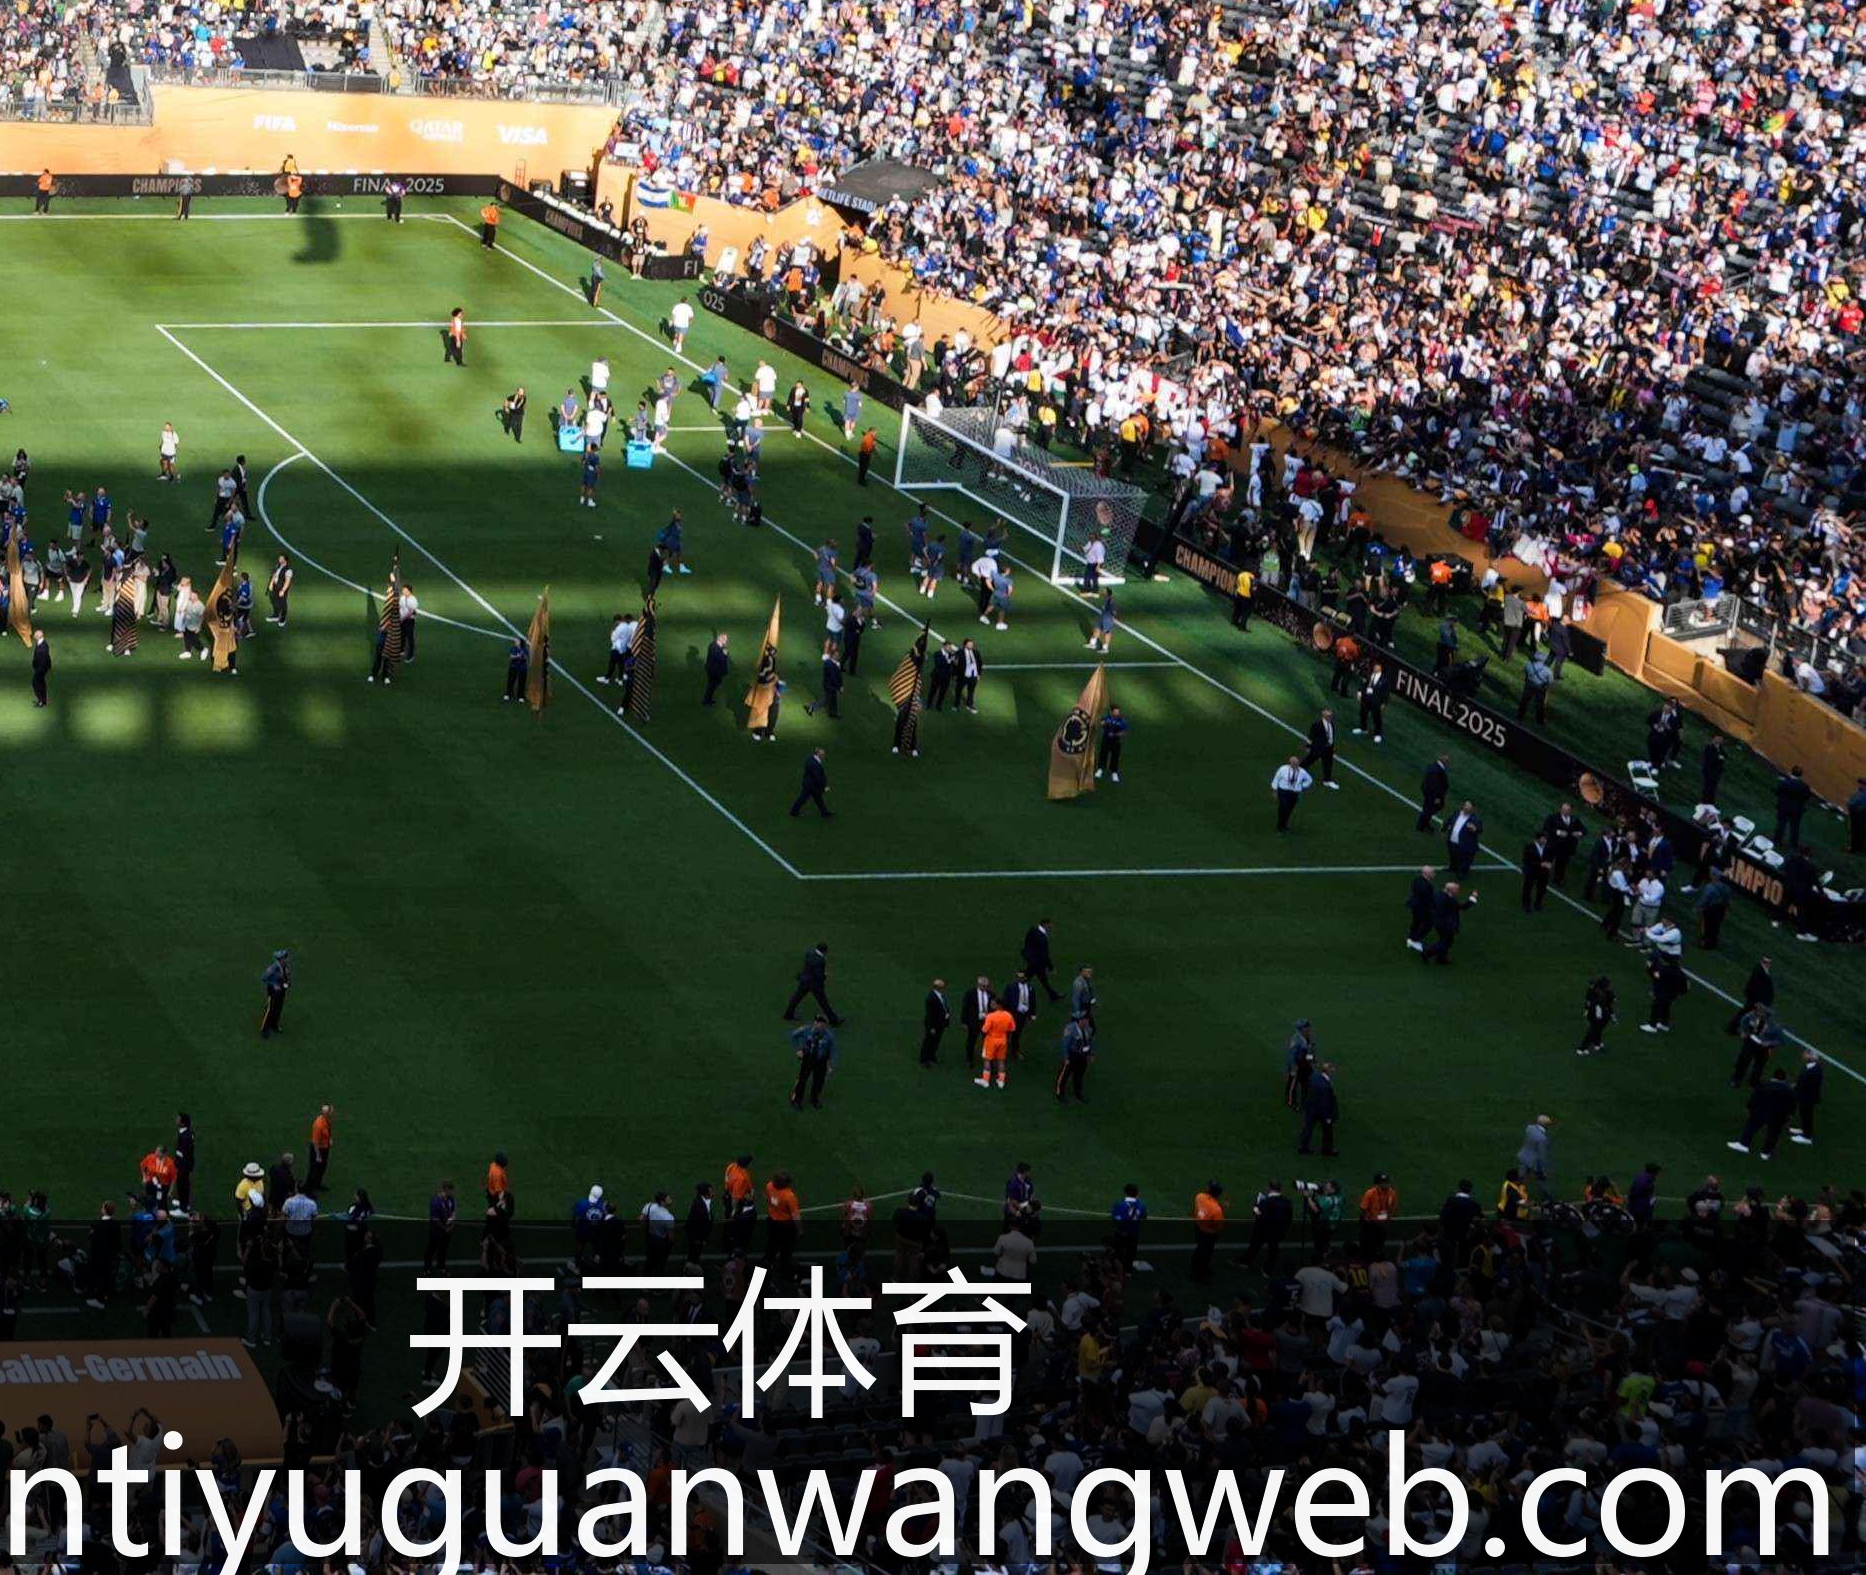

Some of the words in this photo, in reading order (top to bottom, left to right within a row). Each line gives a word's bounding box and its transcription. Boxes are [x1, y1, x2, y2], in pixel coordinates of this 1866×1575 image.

[252, 115, 297, 132] FIFA
[496, 124, 548, 144] VISA
[132, 178, 203, 194] CHAMPIS
[353, 178, 396, 193] FINA
[407, 178, 445, 194] 2025
[1174, 544, 1238, 598] CHAMPION
[1396, 669, 1454, 720] FINAL
[1455, 703, 1507, 748] 2025
